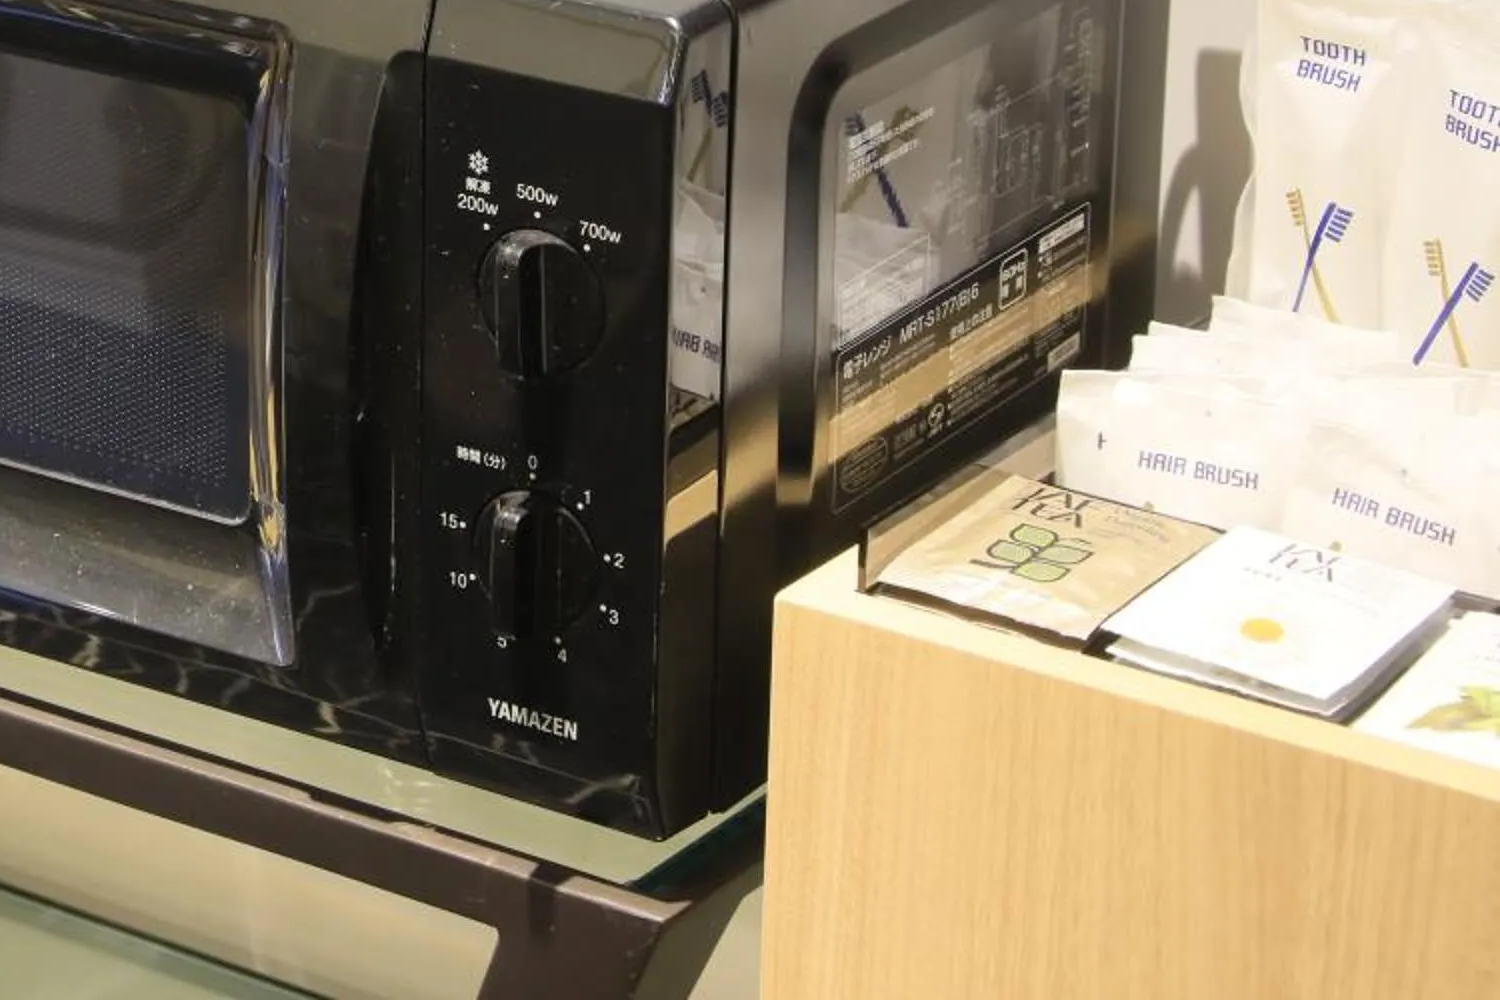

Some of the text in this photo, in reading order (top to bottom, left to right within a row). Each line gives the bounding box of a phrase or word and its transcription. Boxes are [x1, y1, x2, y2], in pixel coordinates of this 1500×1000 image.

[1300, 36, 1366, 66] TOOTH
[1297, 60, 1361, 92] BRUSH
[1449, 89, 1500, 127] TOOT
[528, 455, 537, 469] 0
[1138, 451, 1259, 490] HAIR BRUSH
[583, 490, 591, 505] 1
[440, 512, 458, 530] 15
[1331, 487, 1456, 546] HAIR BRUSH
[613, 553, 625, 569] 2
[450, 571, 467, 588] 10
[609, 609, 619, 625] 3
[557, 648, 567, 663] 4
[487, 697, 578, 741] YAMAZEN
